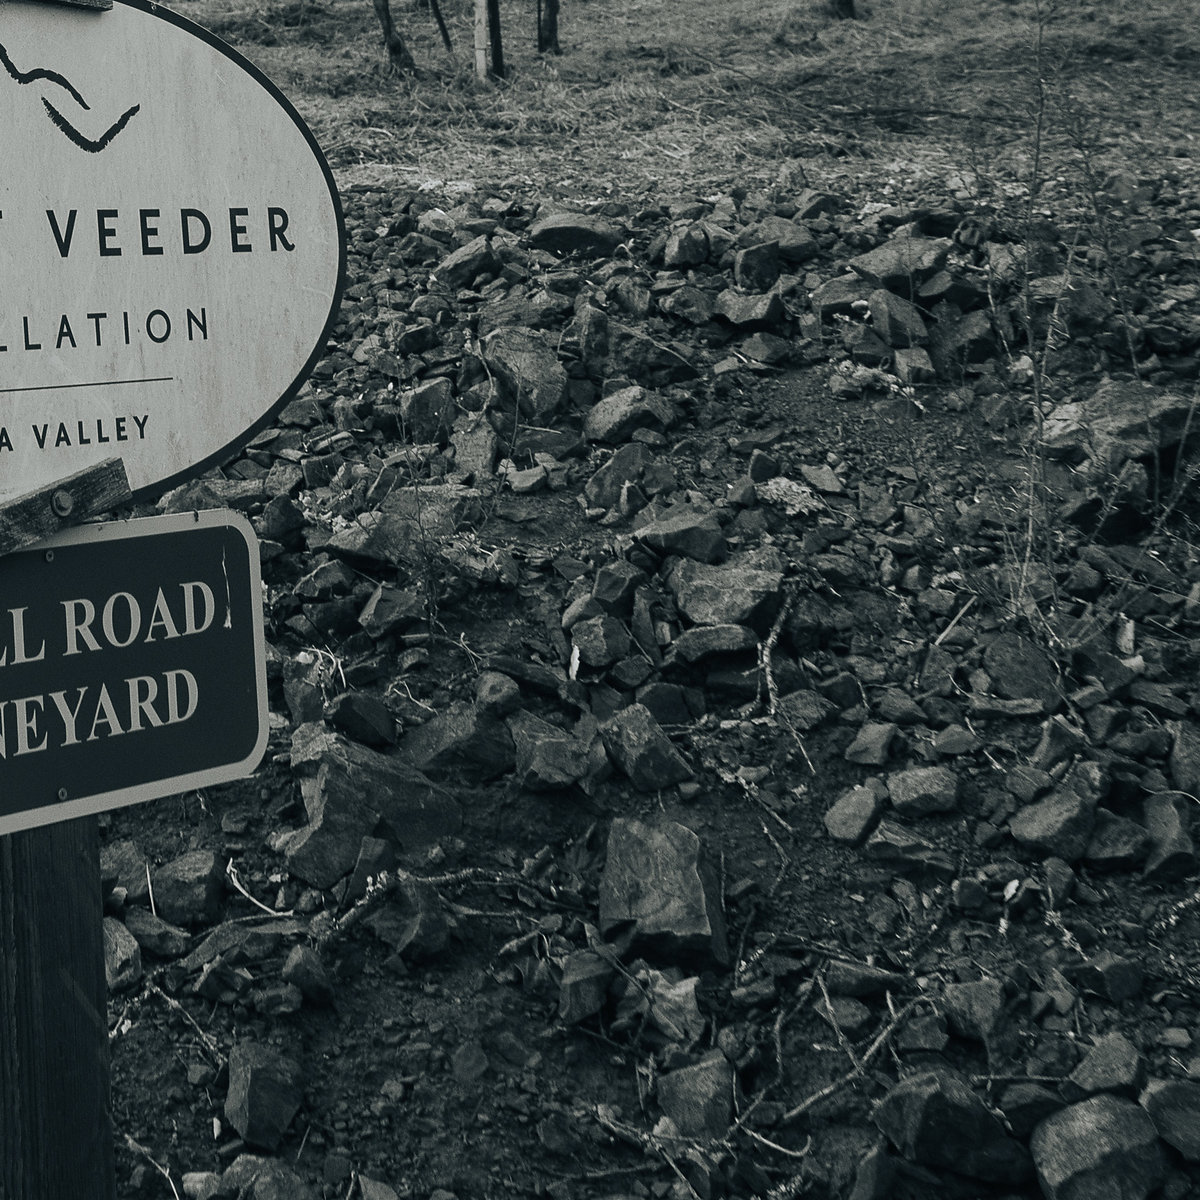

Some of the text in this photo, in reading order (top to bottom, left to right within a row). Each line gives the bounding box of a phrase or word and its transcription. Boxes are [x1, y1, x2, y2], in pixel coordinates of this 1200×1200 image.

[46, 207, 296, 259] VEEDER
[32, 414, 150, 448] VALLEY
[60, 580, 216, 657] ROAD
